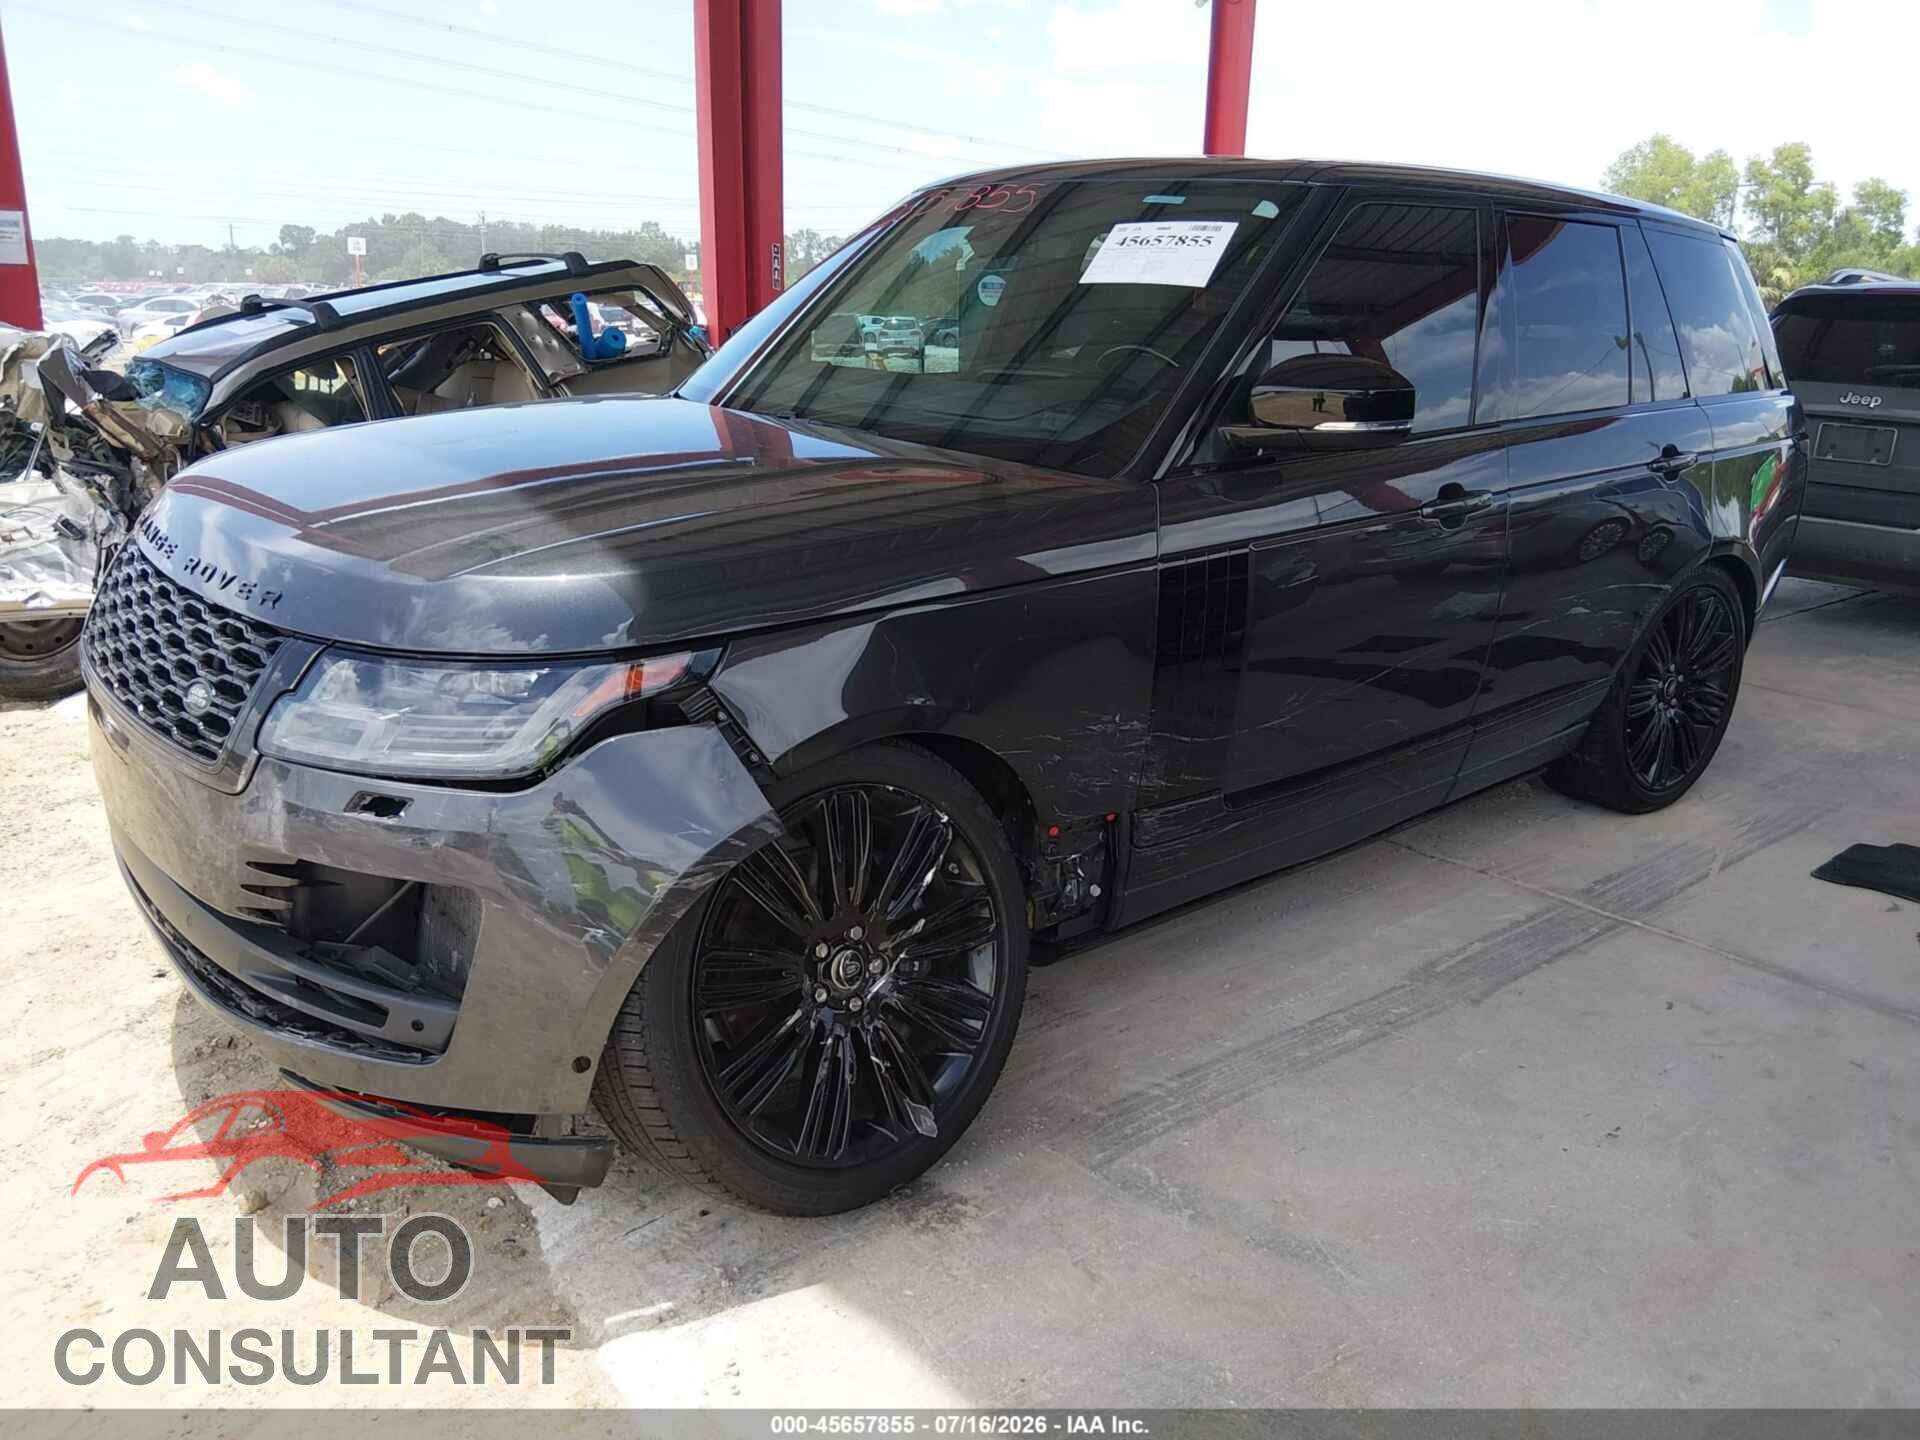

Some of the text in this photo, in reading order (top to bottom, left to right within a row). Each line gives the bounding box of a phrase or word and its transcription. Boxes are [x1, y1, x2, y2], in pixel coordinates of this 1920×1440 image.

[1114, 235, 1215, 248] 45657855
[1839, 391, 1882, 408] Jeep
[184, 557, 283, 610] ROVER
